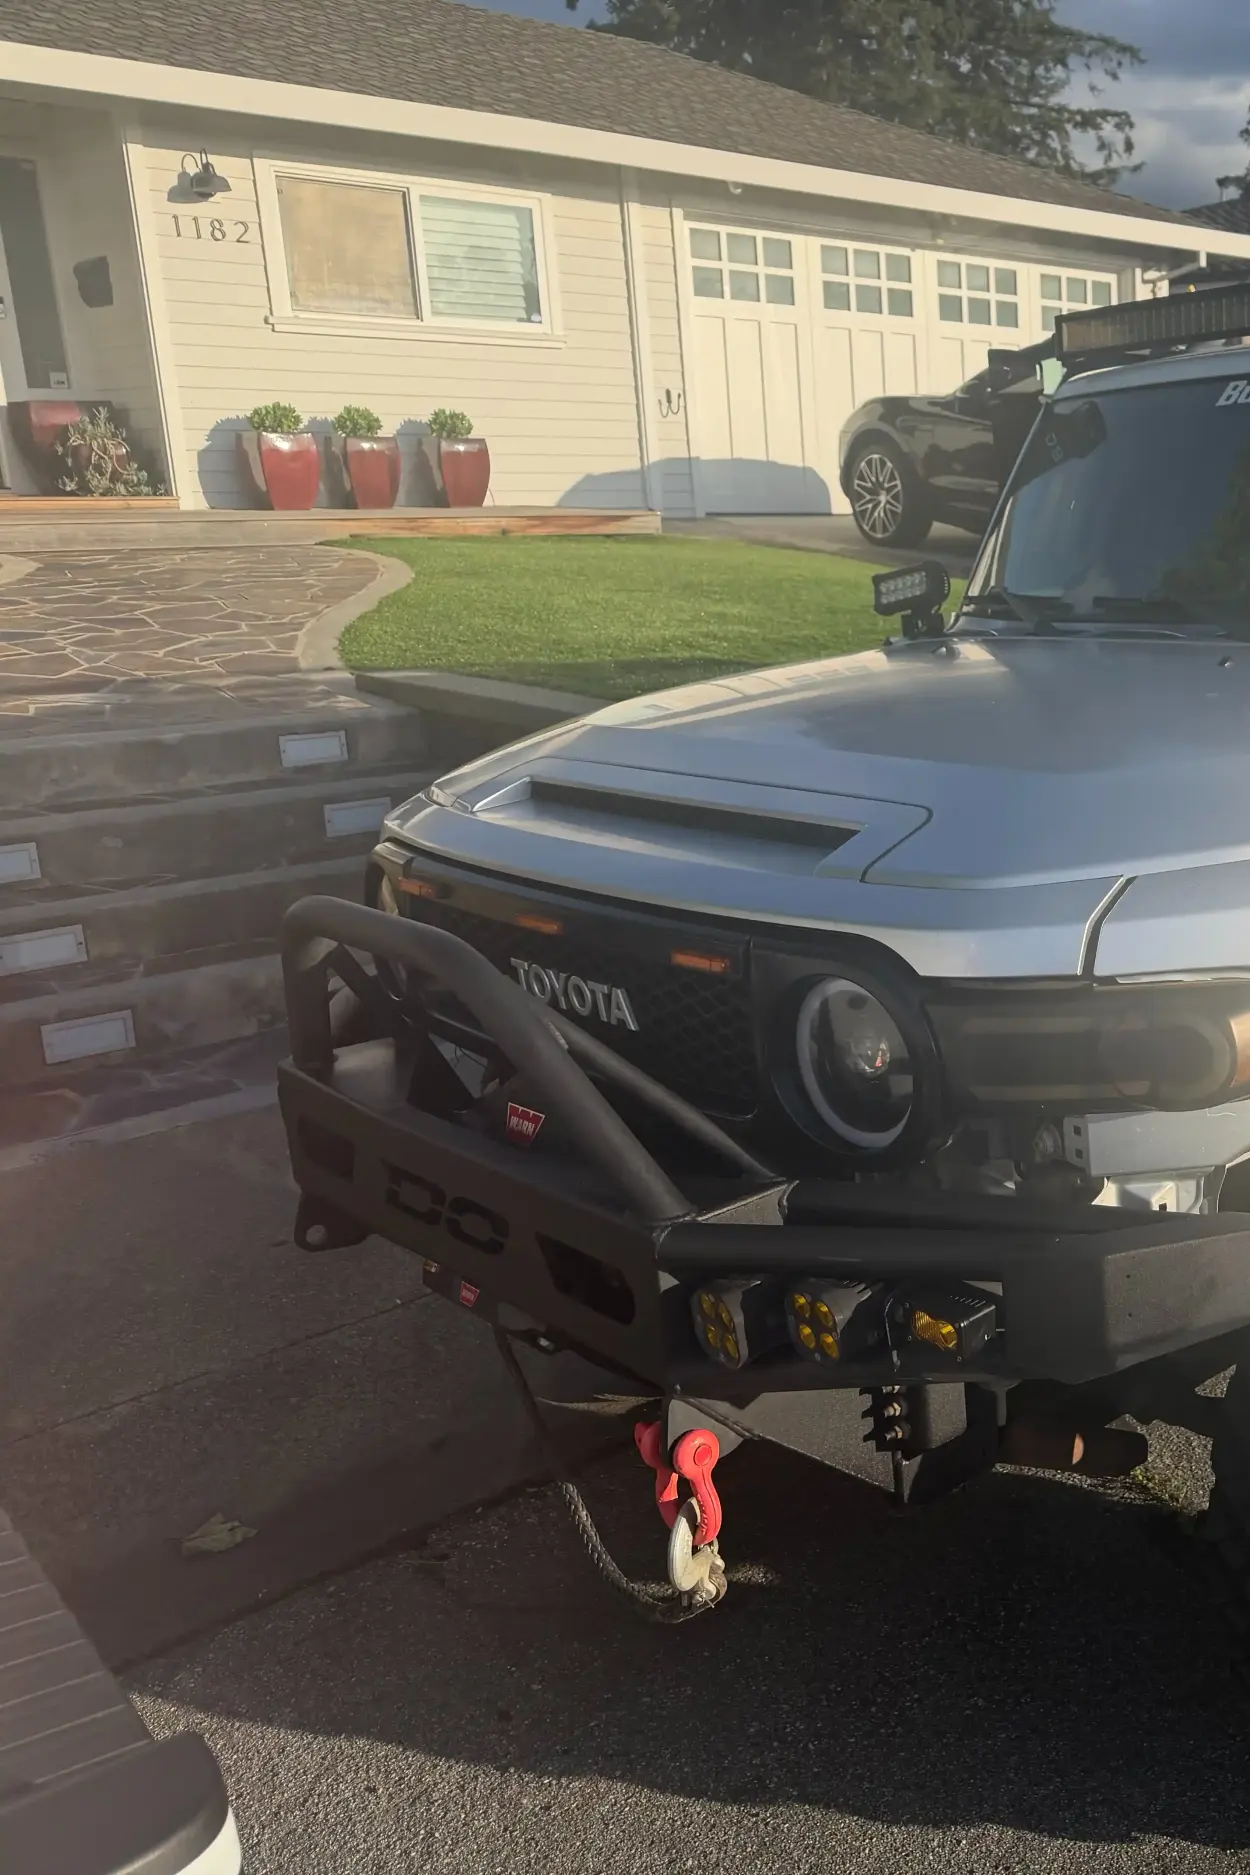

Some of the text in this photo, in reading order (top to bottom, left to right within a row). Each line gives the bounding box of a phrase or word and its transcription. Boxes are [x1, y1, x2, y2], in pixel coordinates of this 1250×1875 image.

[171, 214, 250, 244] 1182
[510, 957, 640, 1032] TOYOTA
[509, 1115, 536, 1138] WARN
